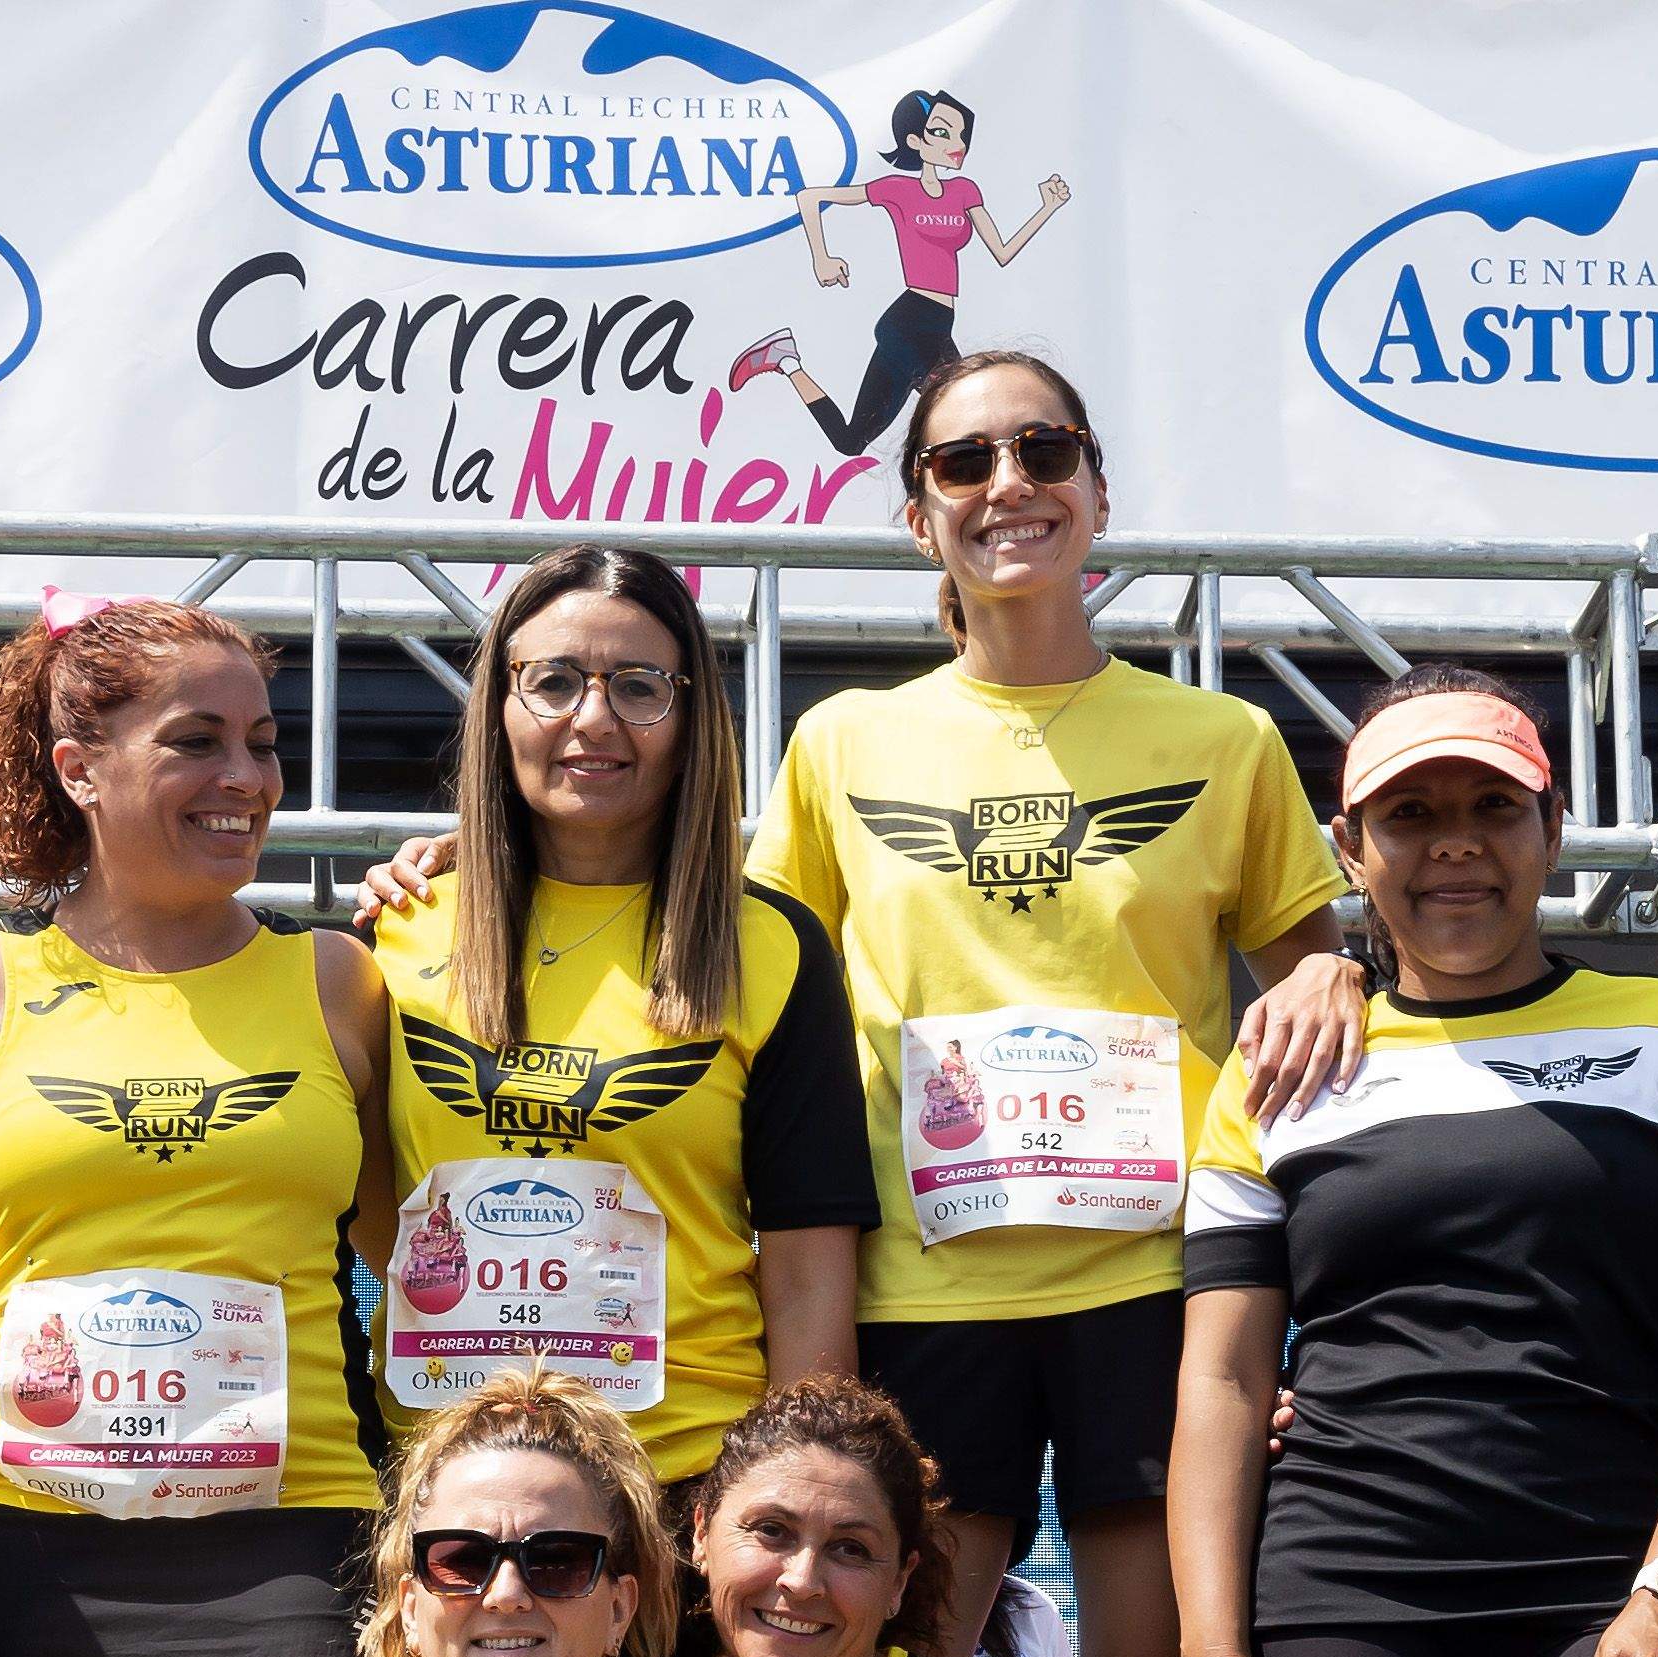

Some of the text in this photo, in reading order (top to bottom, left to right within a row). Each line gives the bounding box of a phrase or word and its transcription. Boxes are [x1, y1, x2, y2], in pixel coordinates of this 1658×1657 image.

[390, 86, 790, 120] CENTRAL LECHERA
[296, 92, 807, 198] ASTURIANA
[915, 214, 966, 226] OYSHO
[196, 252, 693, 396] Carrera
[317, 406, 406, 501] de
[433, 399, 494, 504] la
[978, 799, 1066, 826] BORN
[976, 850, 1066, 881] RUN
[990, 1046, 1089, 1064] ASTURIANA
[1108, 1045, 1157, 1058] SUMA
[500, 1049, 588, 1076] BORN
[131, 1081, 199, 1097] BORN
[494, 1100, 579, 1135] RUN
[997, 1092, 1086, 1122] 016
[131, 1118, 201, 1138] RUN
[1021, 1132, 1062, 1150] 542
[935, 1160, 1157, 1182] CARRERA DE LA MUJER 2023
[934, 1192, 1009, 1221] OYSHO
[1079, 1191, 1162, 1211] Santander
[474, 1201, 575, 1224] ASTURIANA
[477, 1258, 569, 1292] 016
[88, 1312, 192, 1333] ASTURIANA
[212, 1308, 263, 1324] SUMA
[499, 1304, 541, 1324] 548
[419, 1338, 485, 1350] CARRERA
[489, 1337, 509, 1350] DE
[538, 1339, 592, 1351] MUJER
[92, 1369, 187, 1403] 016
[108, 1416, 165, 1437] 4391
[29, 1449, 257, 1463] CARRERA DE LA MUJER 2023
[175, 1480, 260, 1499] Santander
